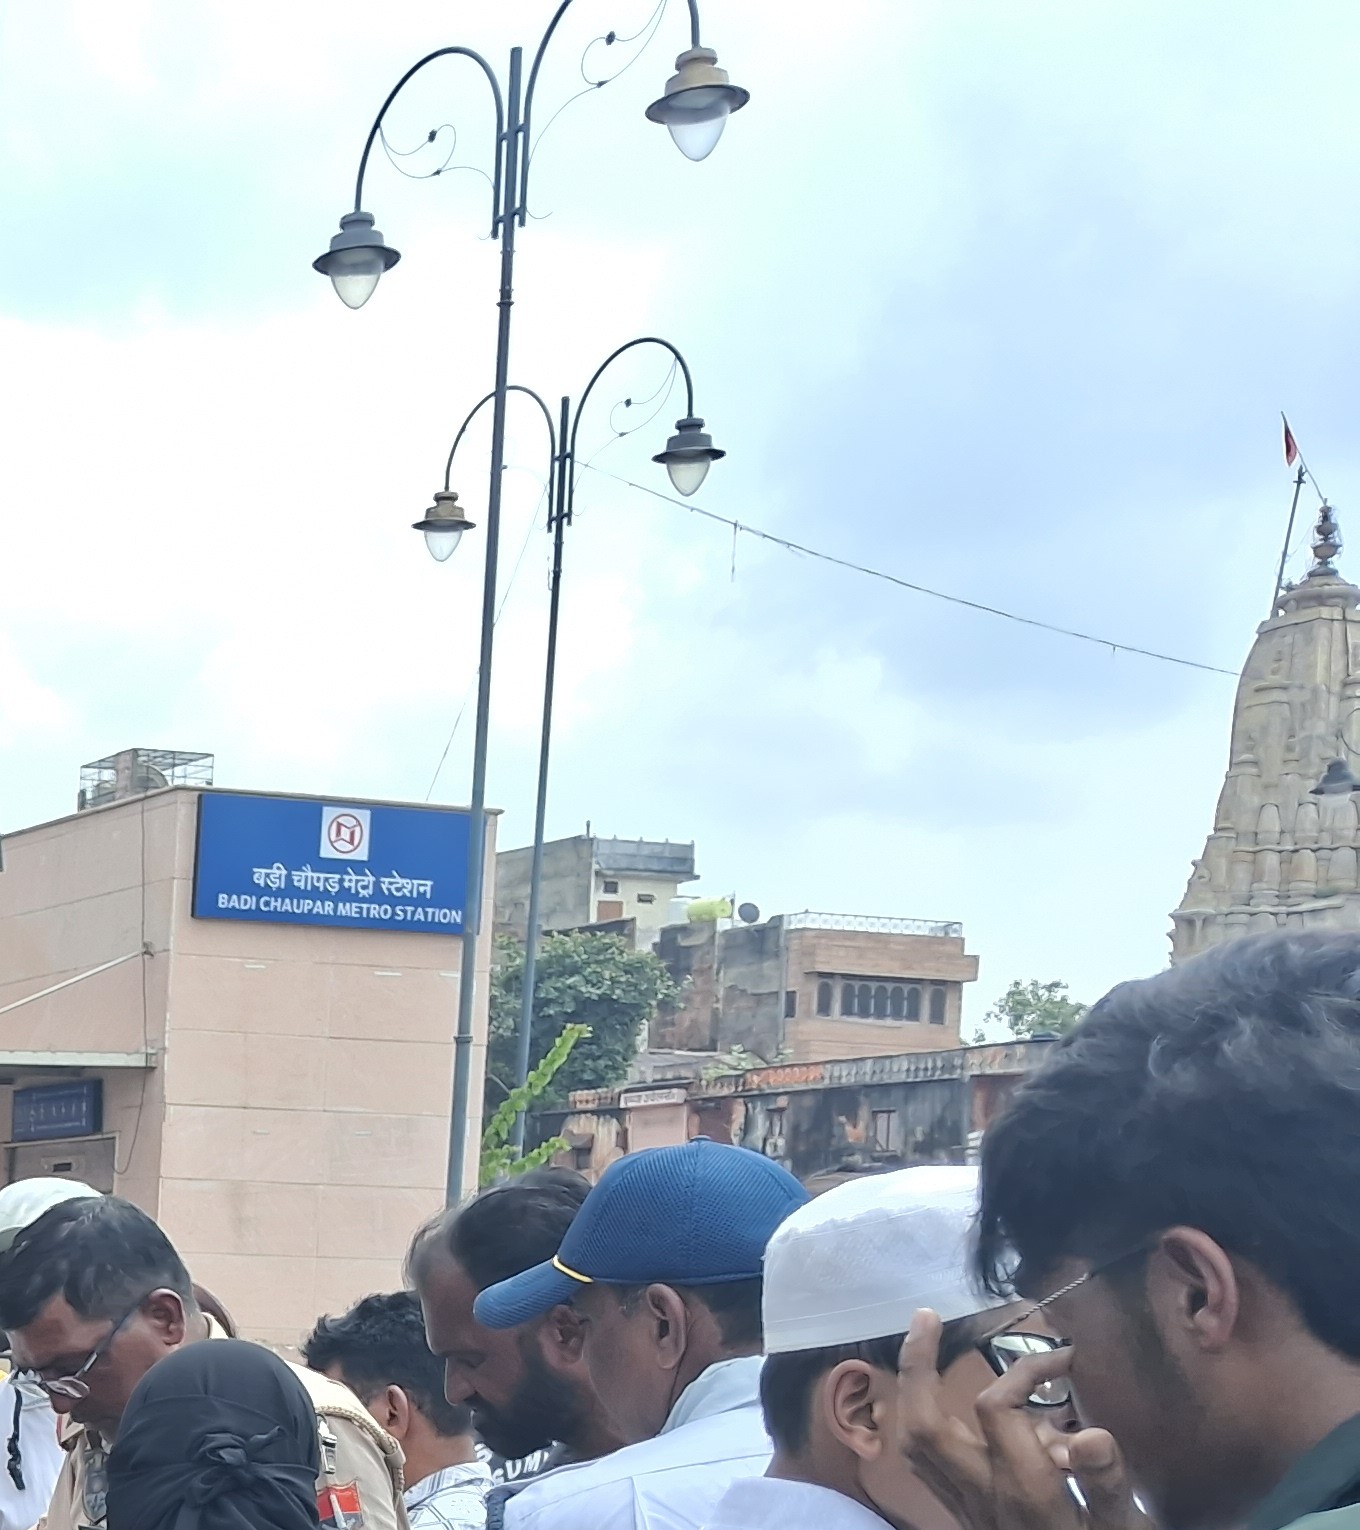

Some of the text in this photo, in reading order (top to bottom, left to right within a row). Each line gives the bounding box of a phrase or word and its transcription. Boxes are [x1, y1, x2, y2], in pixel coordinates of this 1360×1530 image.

[252, 862, 433, 899] बड़ी चौपड़ मेट्रो स्टेशन
[218, 893, 462, 925] BADI CHAUPAR METRO STATION
